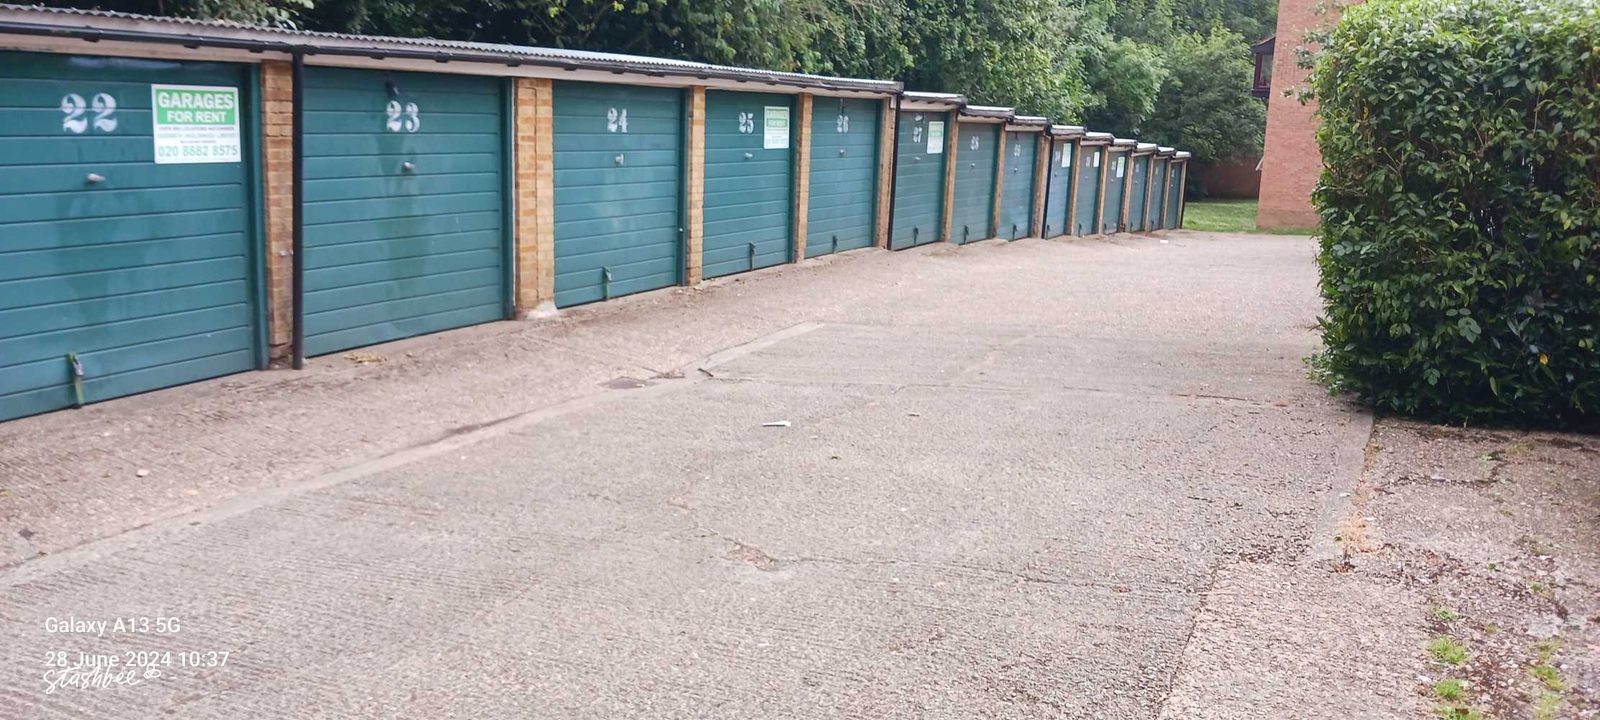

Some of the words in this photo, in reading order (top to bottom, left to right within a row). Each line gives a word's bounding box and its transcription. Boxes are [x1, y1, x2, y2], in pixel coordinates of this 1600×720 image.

[158, 91, 234, 109] GARAGES
[61, 93, 118, 134] 22
[167, 111, 193, 123] FOR
[195, 111, 227, 123] RENT
[386, 100, 420, 133] 23
[607, 107, 628, 133] 24
[738, 111, 754, 134] 25
[836, 114, 849, 134] 26
[913, 126, 922, 143] 27
[158, 145, 179, 157] 020
[183, 145, 208, 156] 8882
[212, 144, 238, 156] 8575
